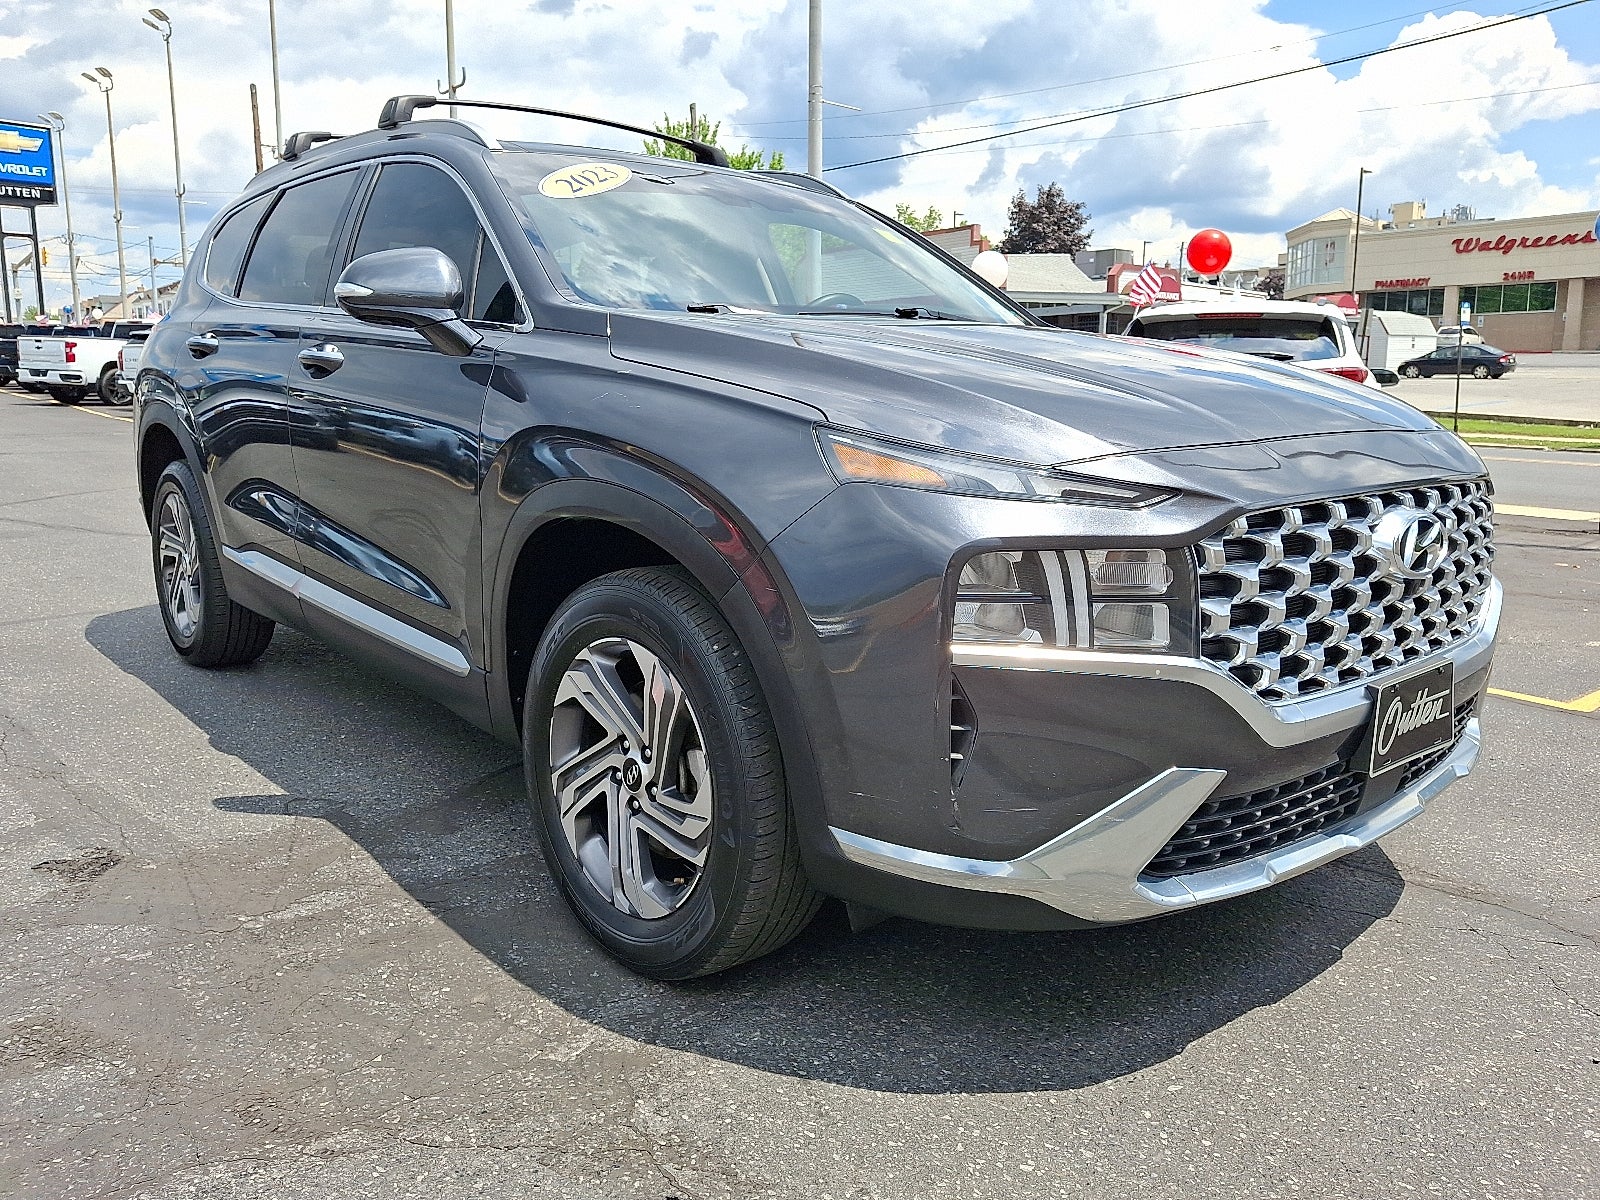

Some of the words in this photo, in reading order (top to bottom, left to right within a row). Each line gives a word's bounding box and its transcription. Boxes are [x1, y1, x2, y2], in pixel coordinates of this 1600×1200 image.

[555, 166, 619, 193] 2023
[1452, 230, 1597, 255] Walgreens
[1374, 277, 1431, 289] PHARMACY
[1502, 271, 1535, 281] 24HR
[1377, 687, 1450, 756] Outten
